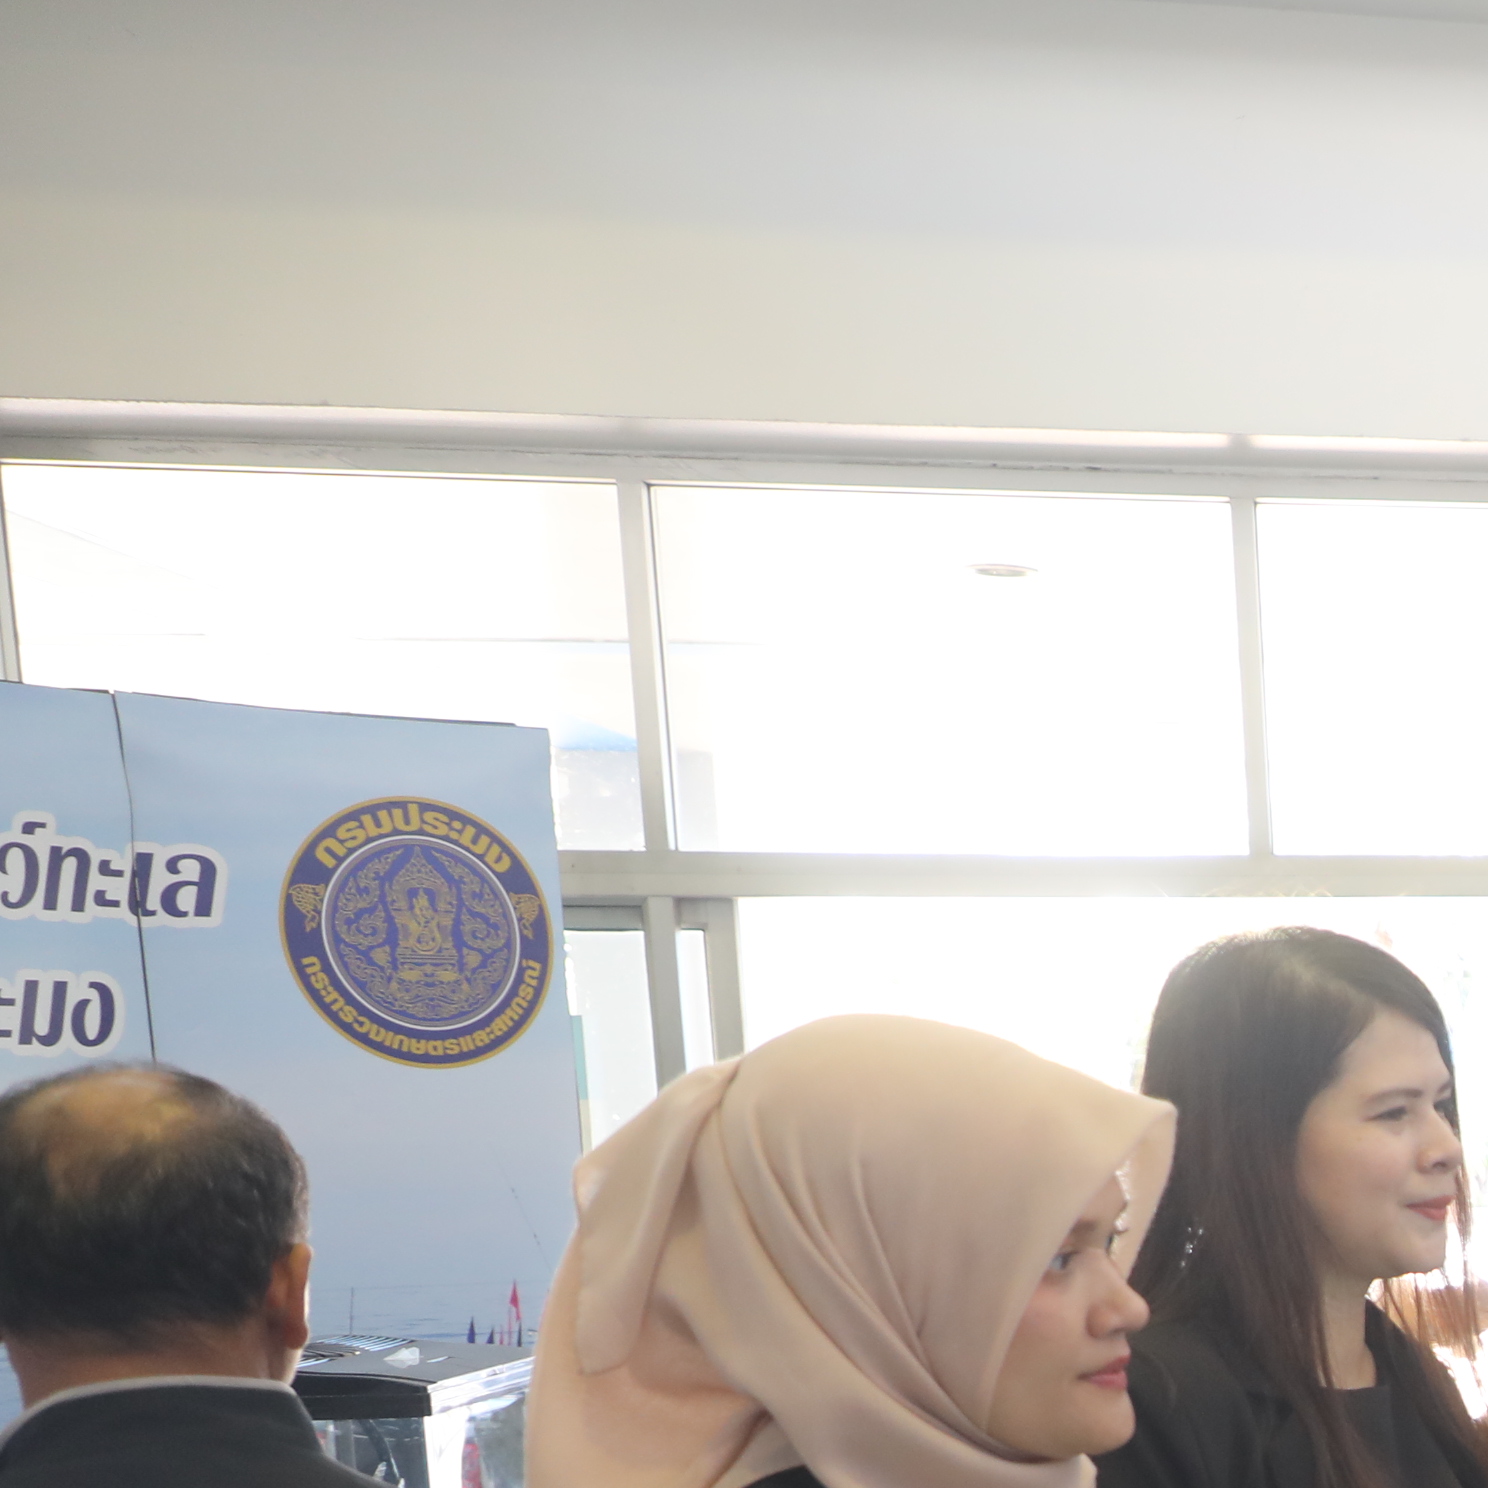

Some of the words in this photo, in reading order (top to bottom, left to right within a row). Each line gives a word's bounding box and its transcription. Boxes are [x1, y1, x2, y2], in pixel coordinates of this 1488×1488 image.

[314, 803, 511, 873] กรมประมง
[301, 956, 543, 1056] กระทรวงเกษตรและสหกรณ์
